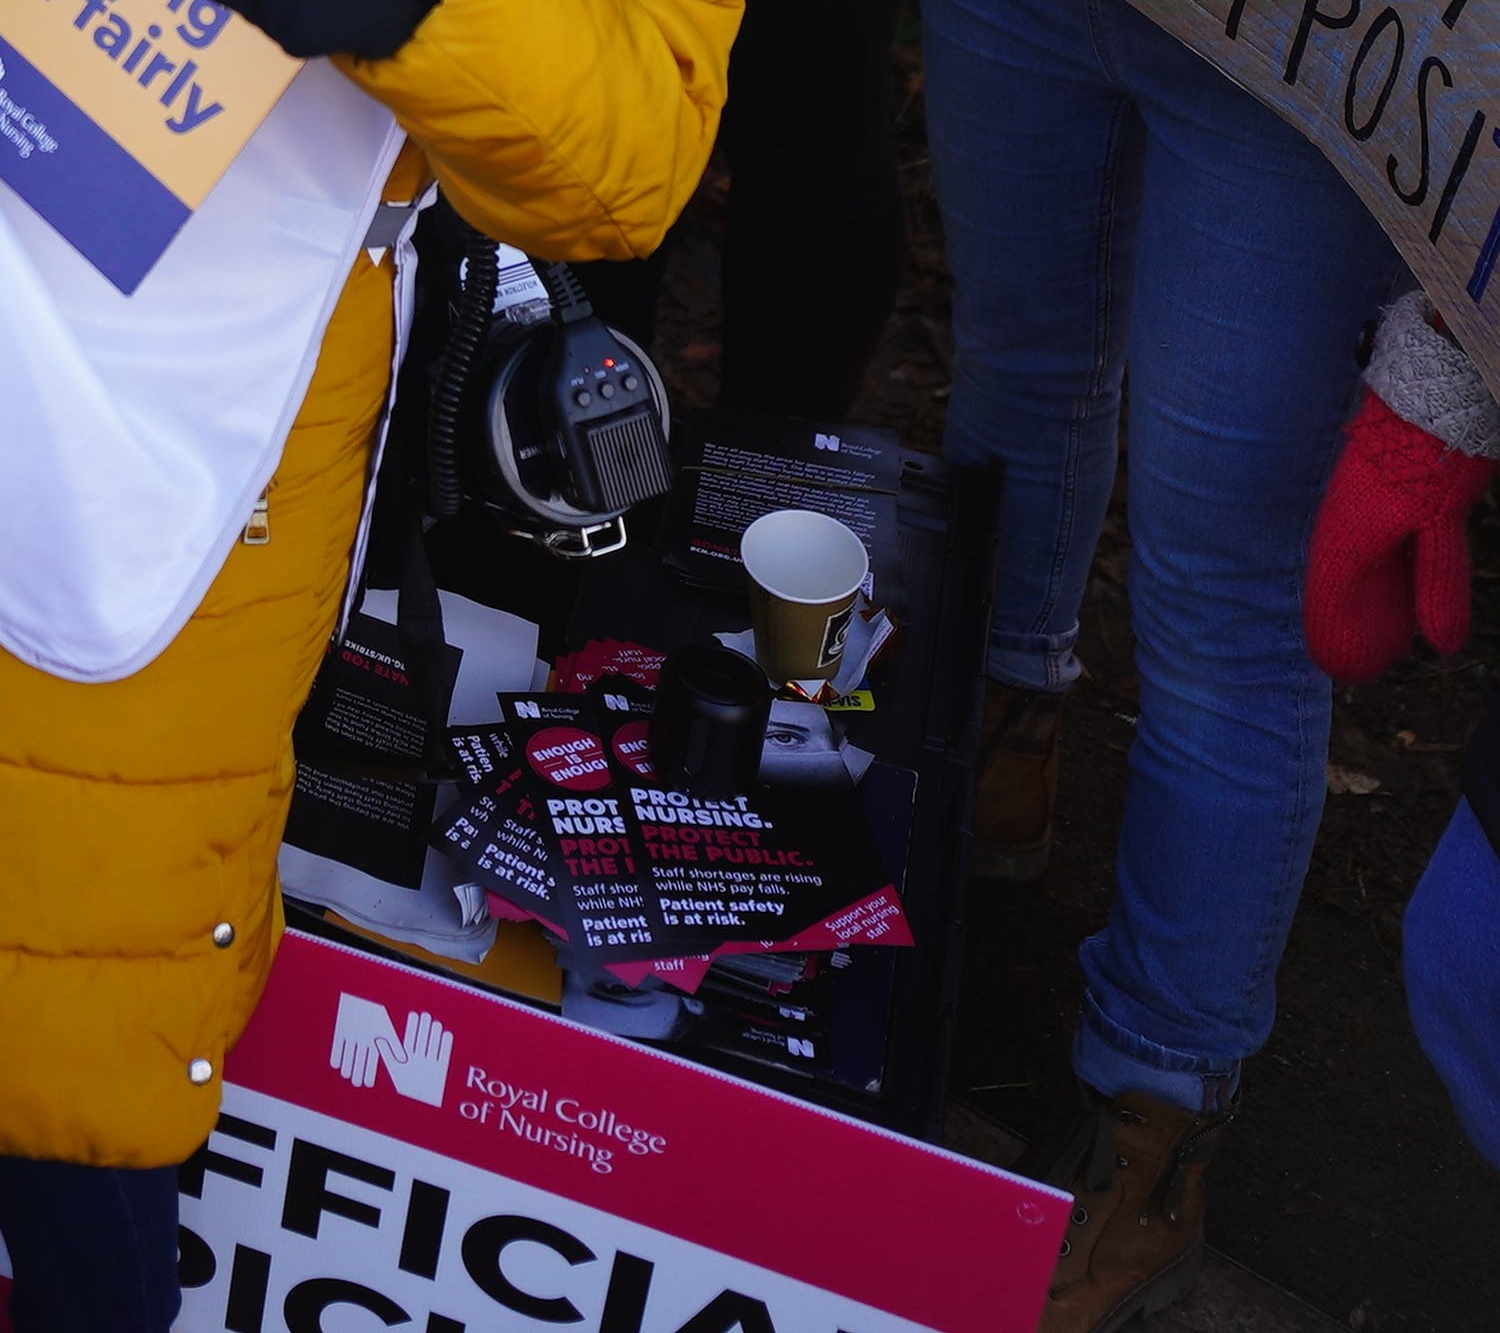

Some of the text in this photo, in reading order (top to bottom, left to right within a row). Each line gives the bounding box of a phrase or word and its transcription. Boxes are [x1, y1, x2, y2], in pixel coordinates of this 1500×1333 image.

[21, 112, 59, 153] College
[532, 737, 596, 761] ENOUGH
[564, 754, 582, 765] IS
[633, 806, 775, 830] NURSING.
[640, 824, 762, 847] PROTECT
[646, 842, 815, 867] THE PUBLIC.
[652, 867, 823, 887] Staff shortages are rising
[655, 881, 791, 897] while NHS pay falls.
[659, 897, 785, 916] Patient safety
[825, 895, 887, 933] Support your
[582, 915, 648, 931] Patient
[662, 912, 747, 926] is at risk.
[836, 904, 900, 941] local nursing
[867, 921, 891, 940] staff
[654, 959, 686, 972] staff
[465, 1065, 668, 1157] Royal College
[459, 1098, 615, 1175] of Nursing
